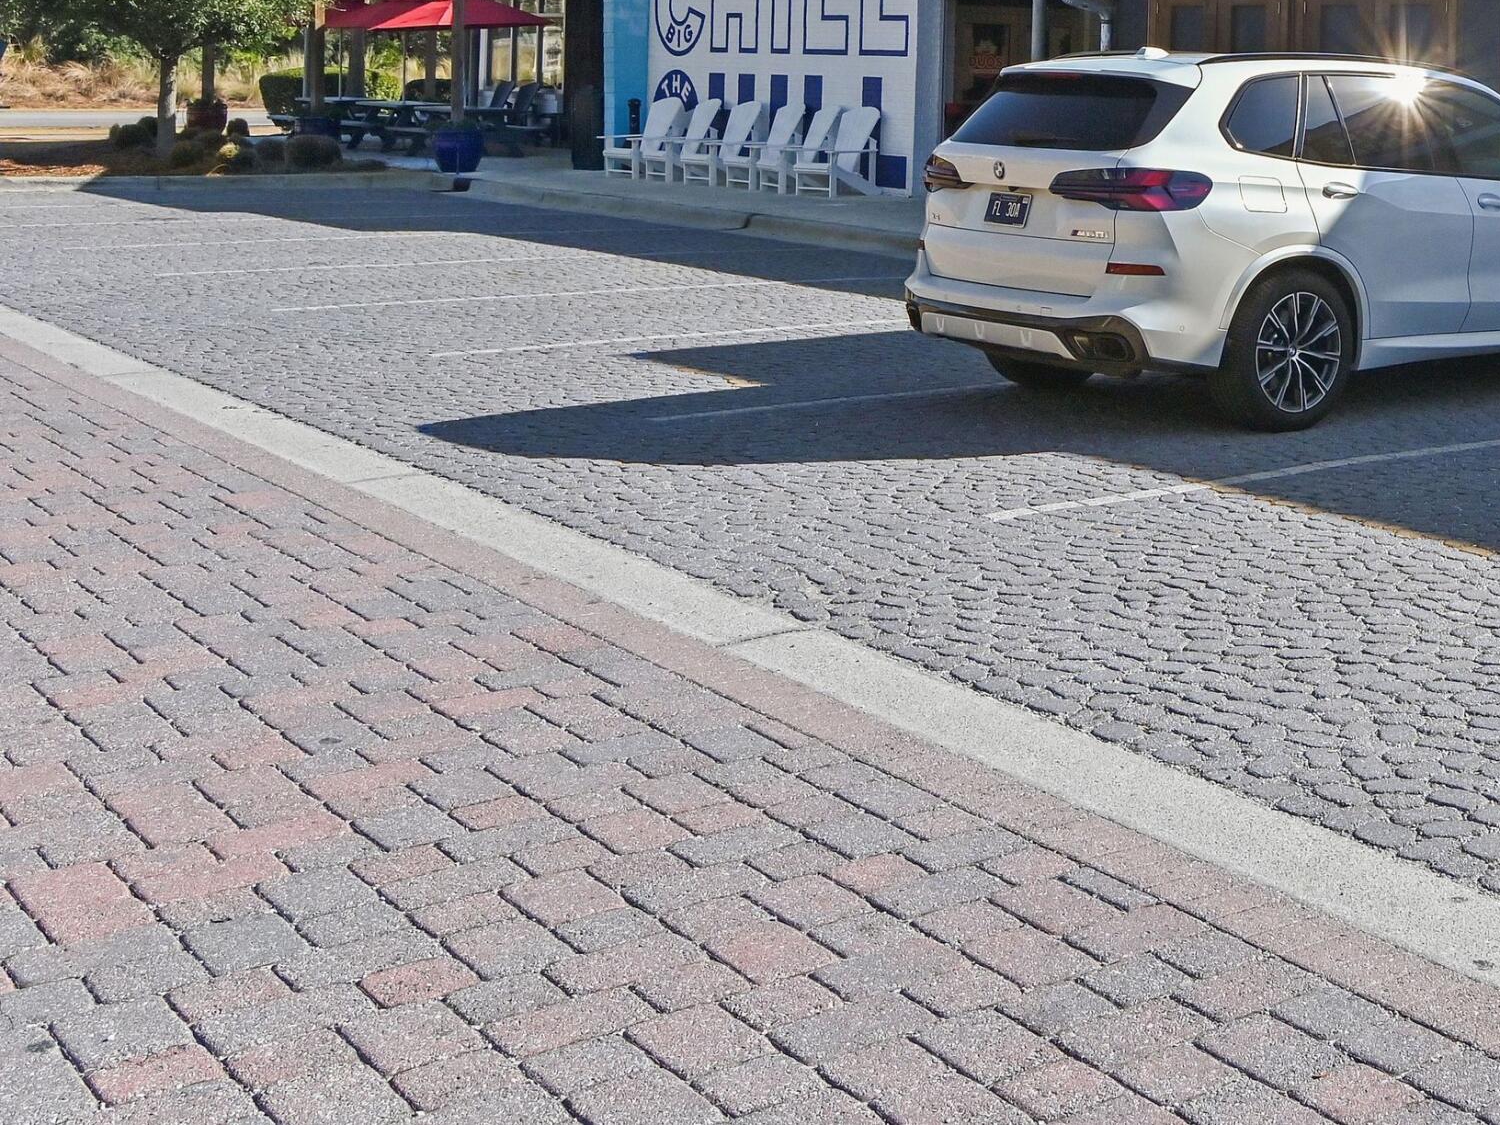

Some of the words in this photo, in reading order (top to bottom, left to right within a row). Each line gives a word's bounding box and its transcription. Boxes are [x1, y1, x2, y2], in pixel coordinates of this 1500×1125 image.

[665, 23, 694, 48] BIG
[661, 74, 692, 102] THE
[992, 200, 1001, 216] FL
